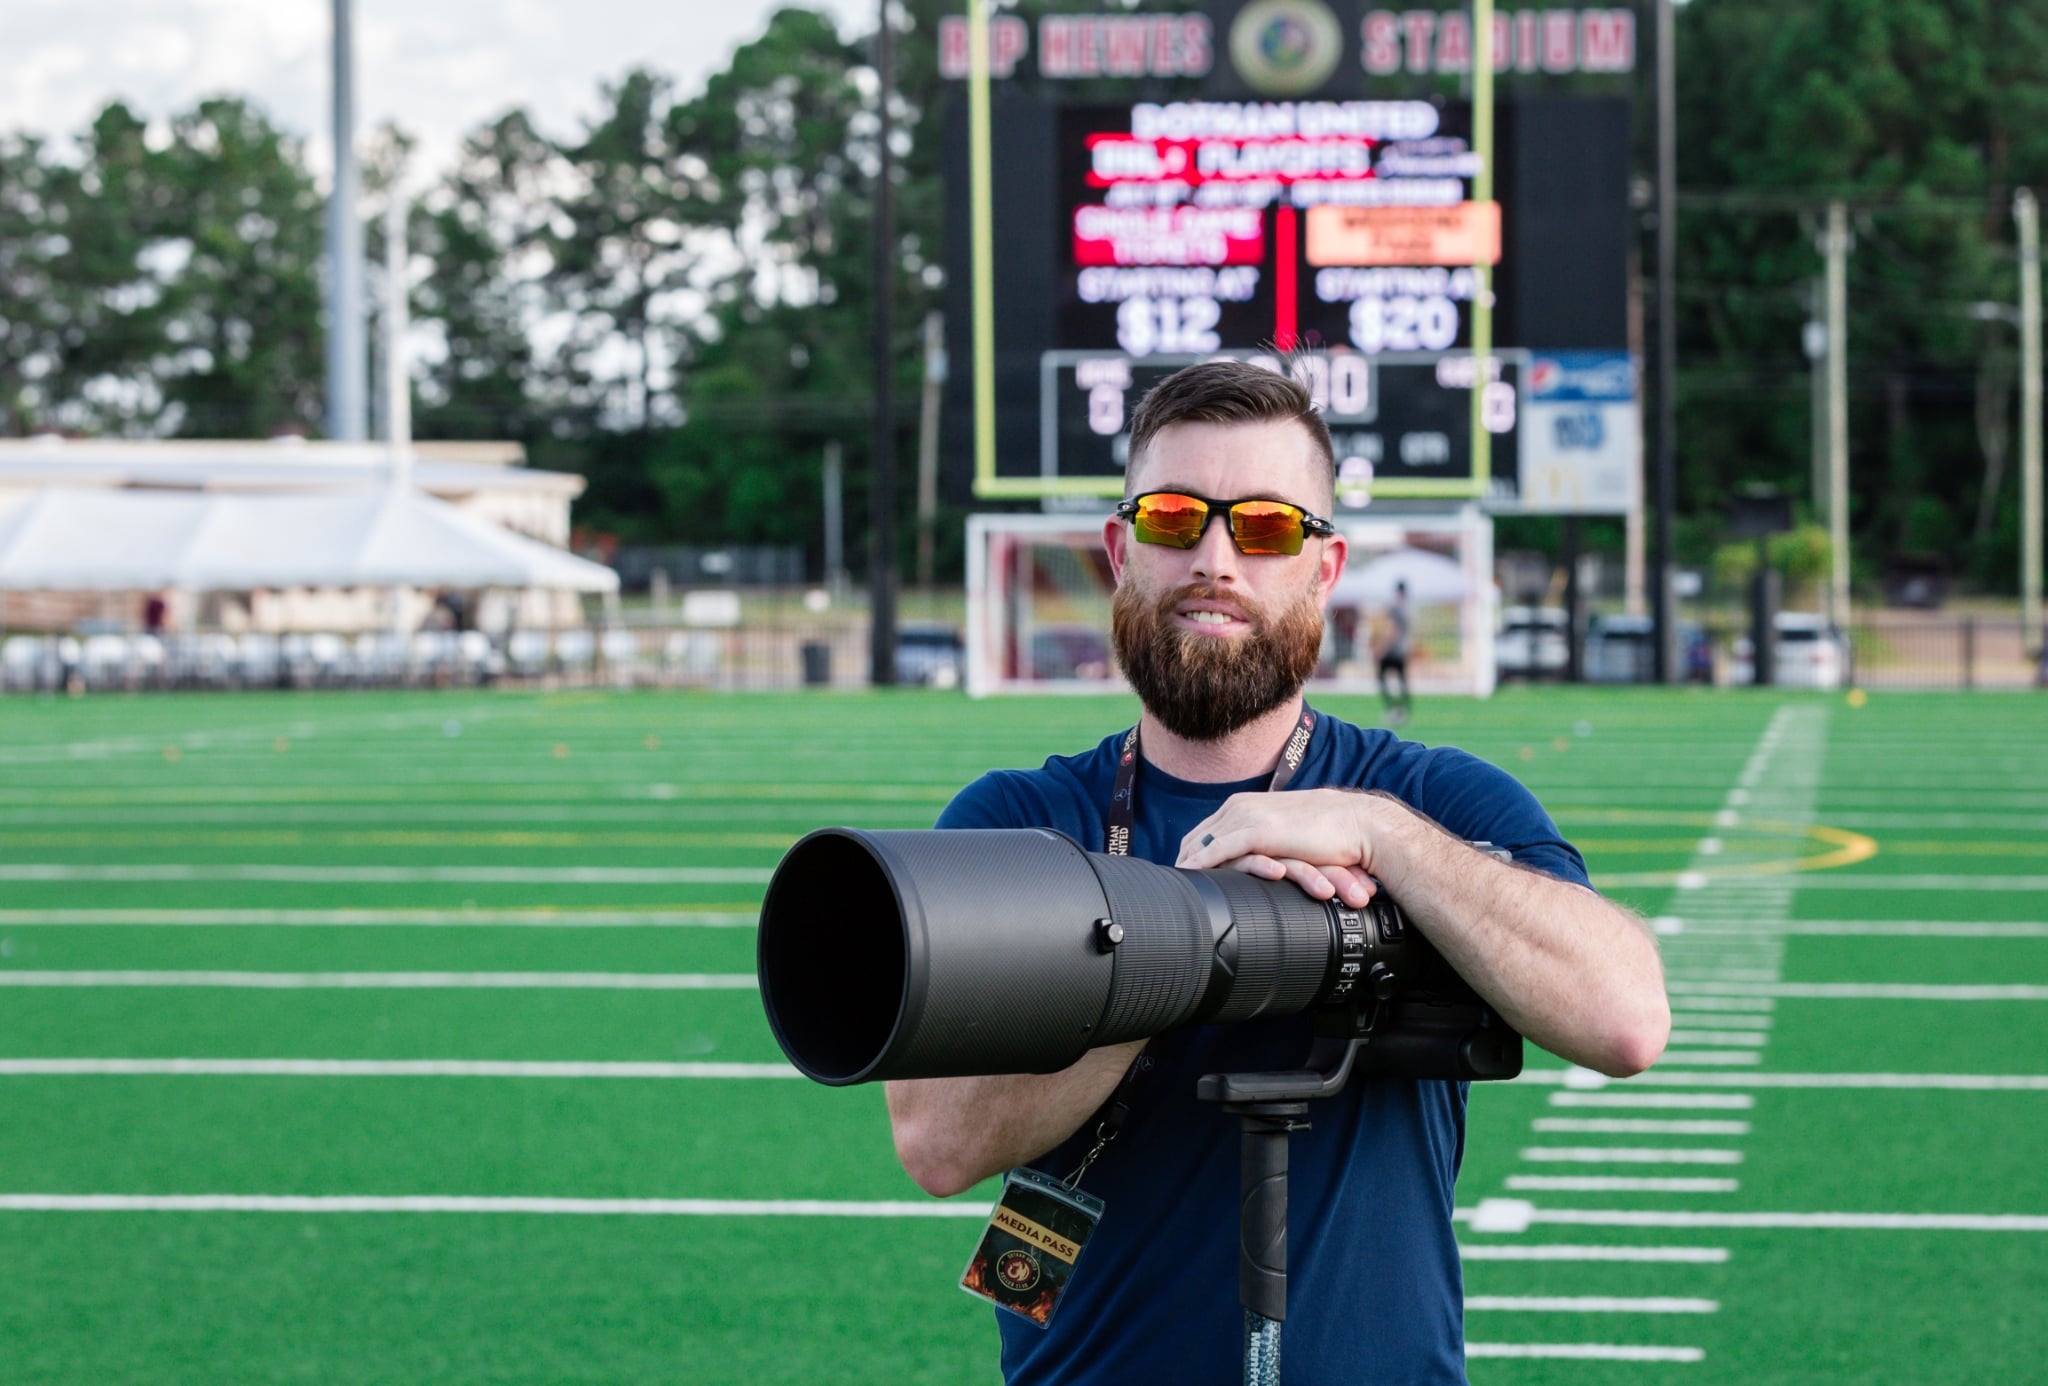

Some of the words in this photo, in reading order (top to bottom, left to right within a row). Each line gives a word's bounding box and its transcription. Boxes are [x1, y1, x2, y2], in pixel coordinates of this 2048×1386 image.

[938, 14, 1030, 79] RP
[1038, 12, 1214, 78] HEWES
[1116, 295, 1221, 357] $12
[1348, 295, 1459, 356] $20
[1284, 726, 1304, 761] UNITED
[1288, 729, 1310, 771] DOTHAN
[1109, 825, 1120, 856] OTHAN
[1118, 827, 1129, 857] NITED
[996, 1212, 1040, 1241] MEDIA
[1042, 1235, 1074, 1258] PASS
